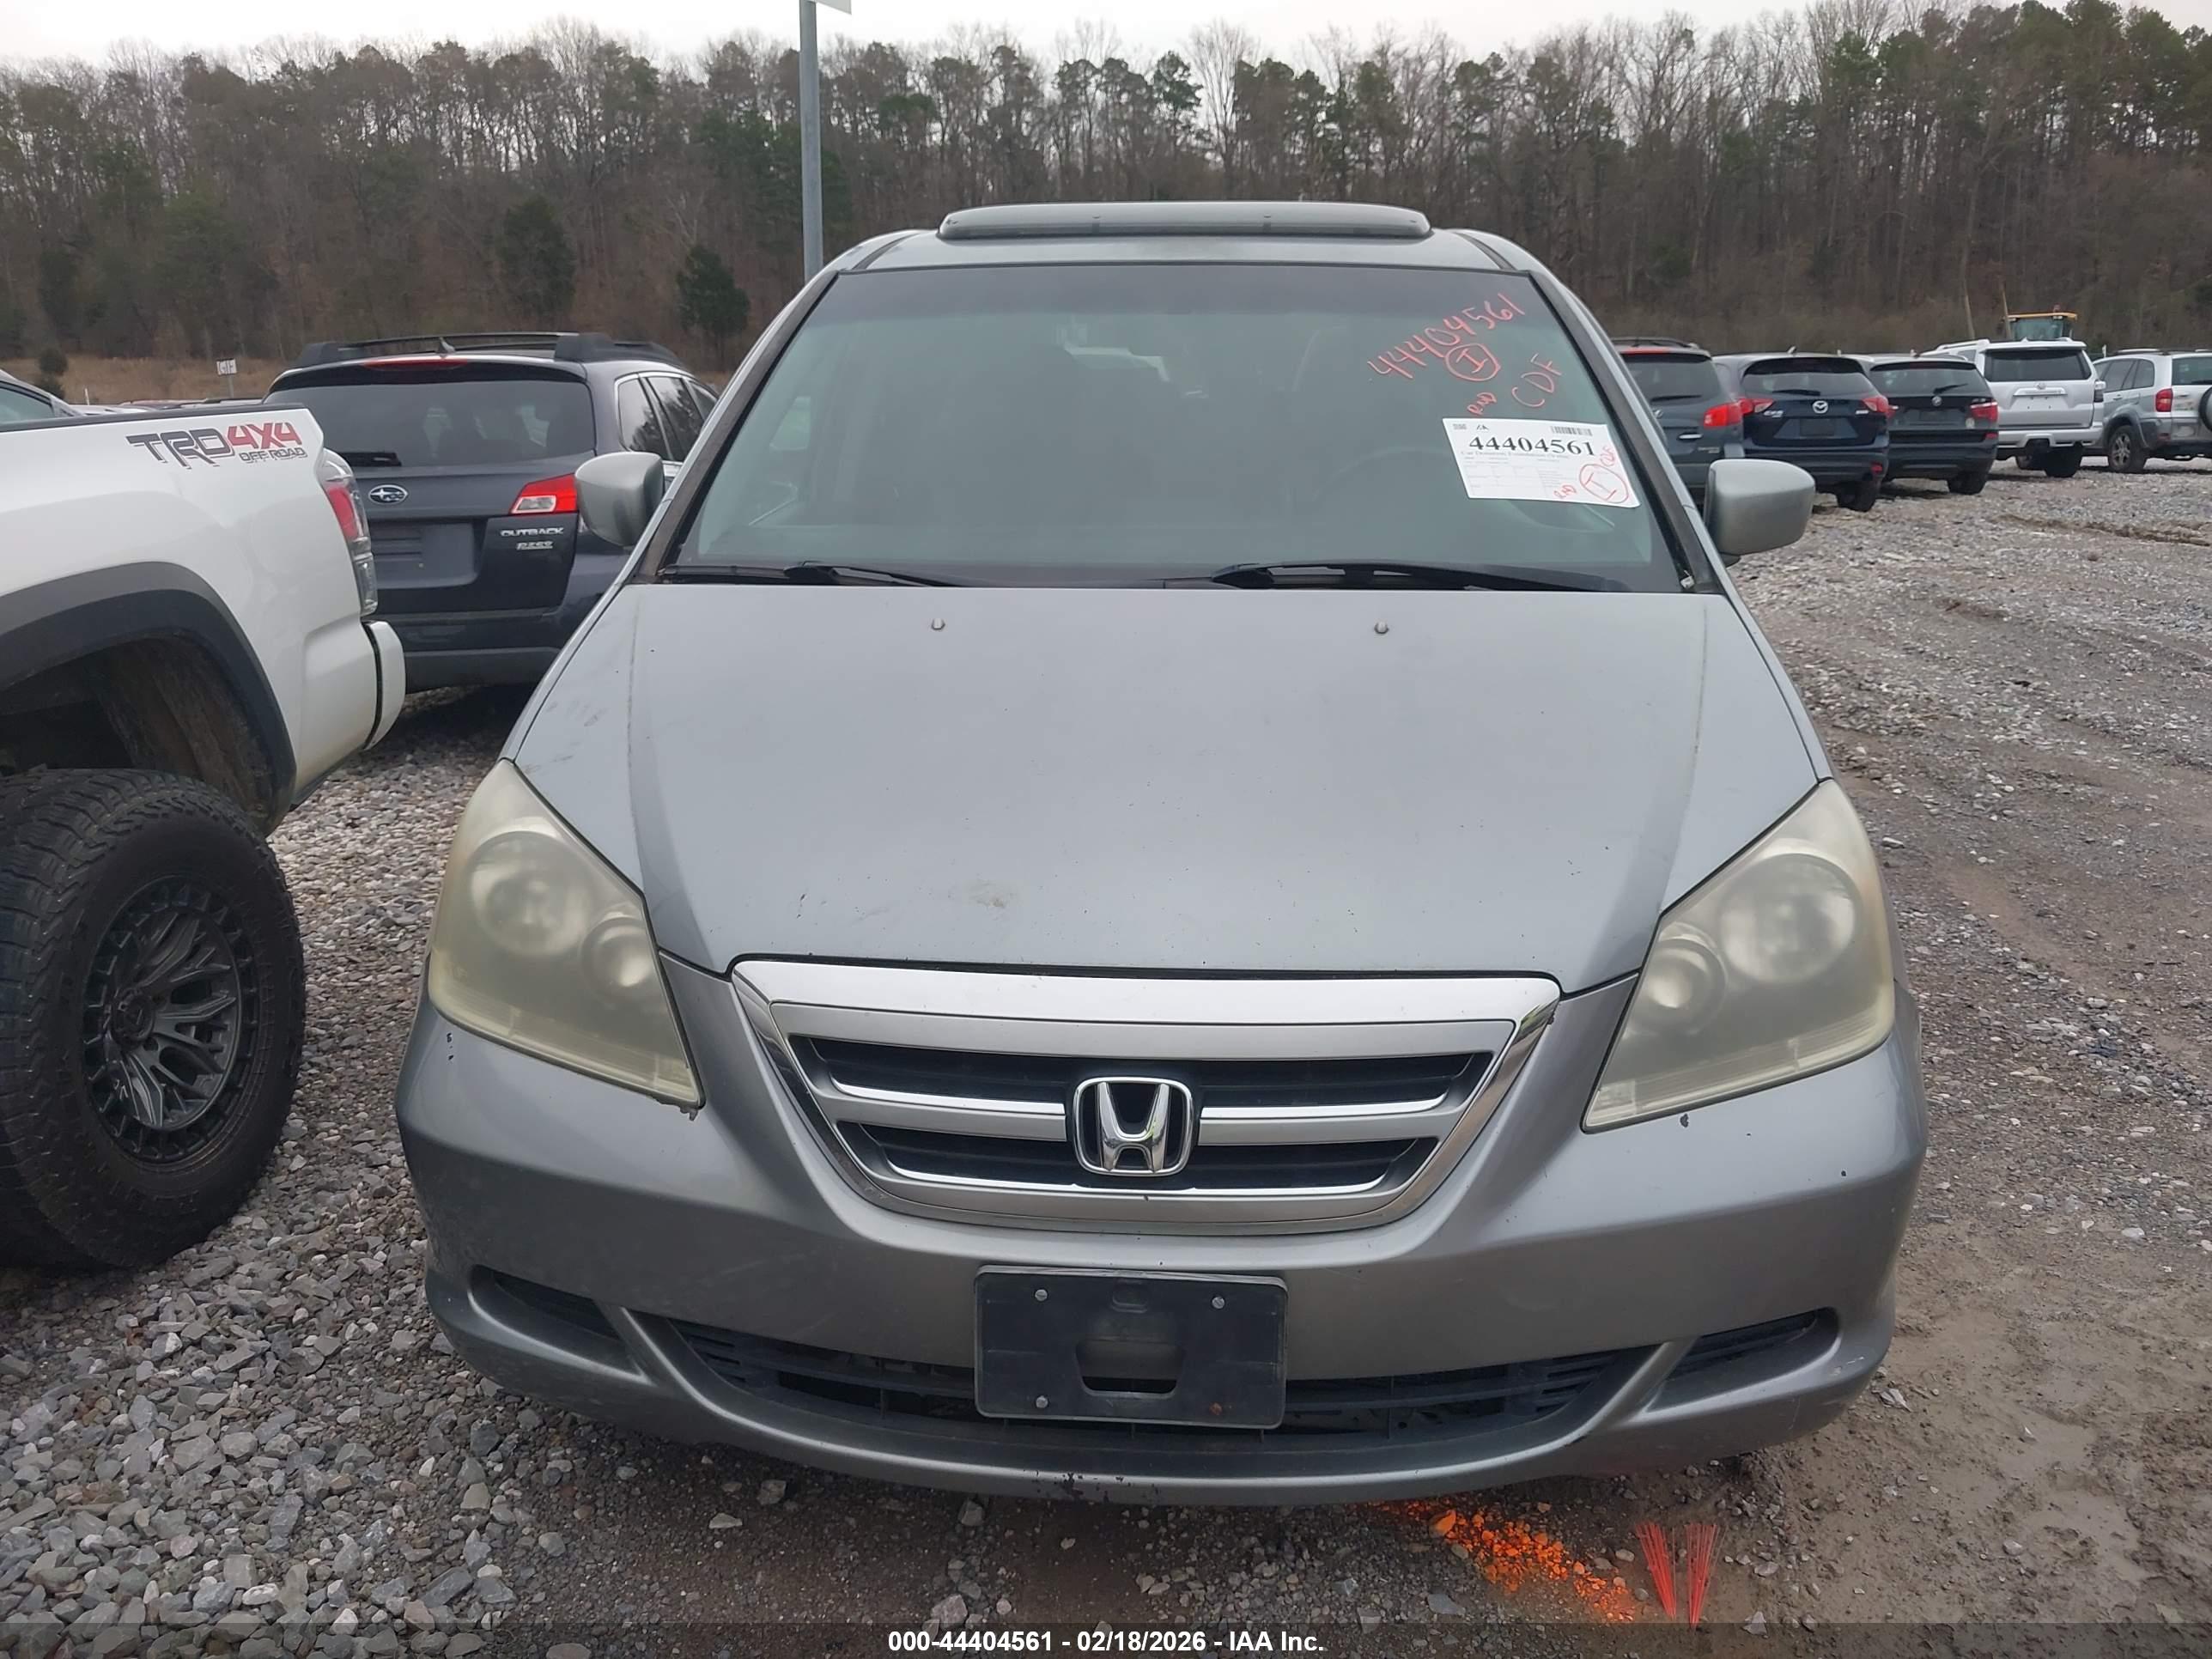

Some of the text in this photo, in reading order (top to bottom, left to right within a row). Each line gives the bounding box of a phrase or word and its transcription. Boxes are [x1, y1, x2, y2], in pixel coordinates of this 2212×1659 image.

[1367, 293, 1525, 379] 44404561
[1511, 353, 1562, 407] CDF
[125, 422, 303, 470] TRD 4X4
[239, 447, 308, 464] OFF ROAD
[1469, 435, 1596, 456] 44404561
[501, 527, 564, 537] OUTBACK
